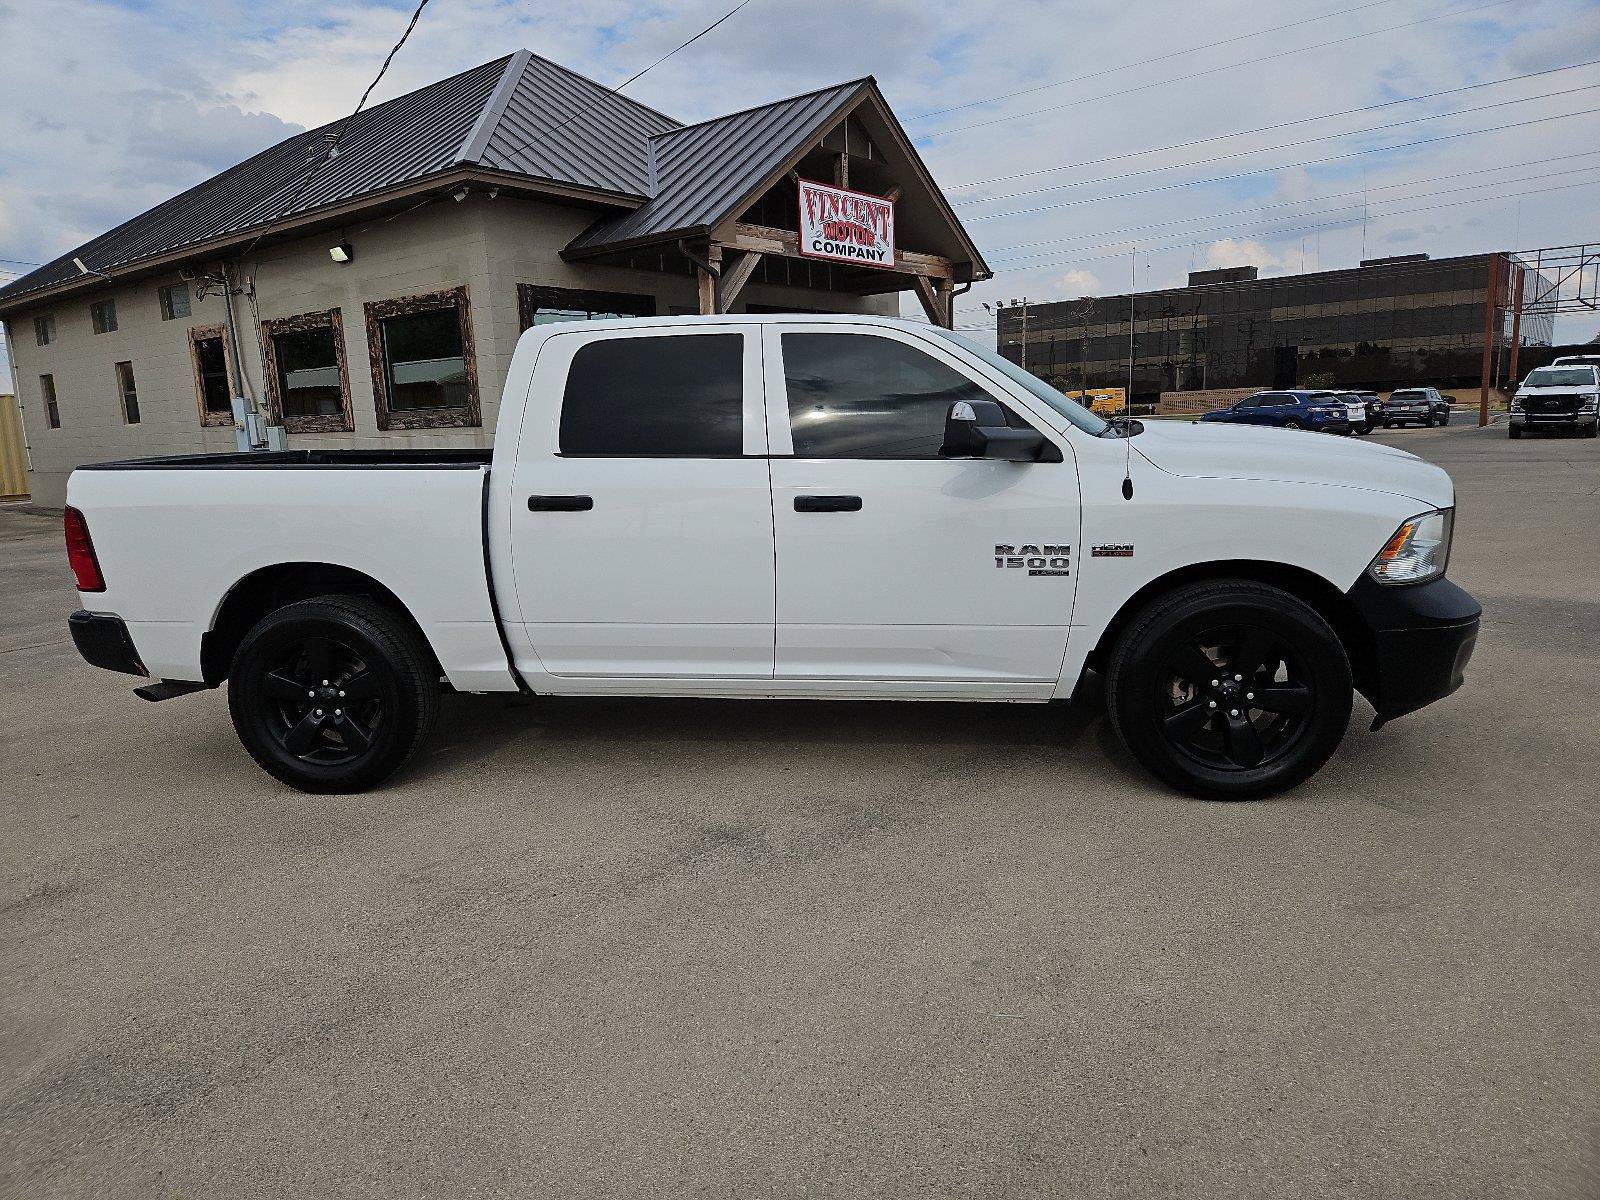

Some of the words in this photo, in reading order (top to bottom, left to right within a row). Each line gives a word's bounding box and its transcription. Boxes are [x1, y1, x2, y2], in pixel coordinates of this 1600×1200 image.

[803, 186, 891, 247] VINCENT
[822, 220, 875, 248] MOTOR
[812, 240, 886, 261] COMPANY
[995, 543, 1071, 555] RAM
[995, 557, 1070, 568] 1500
